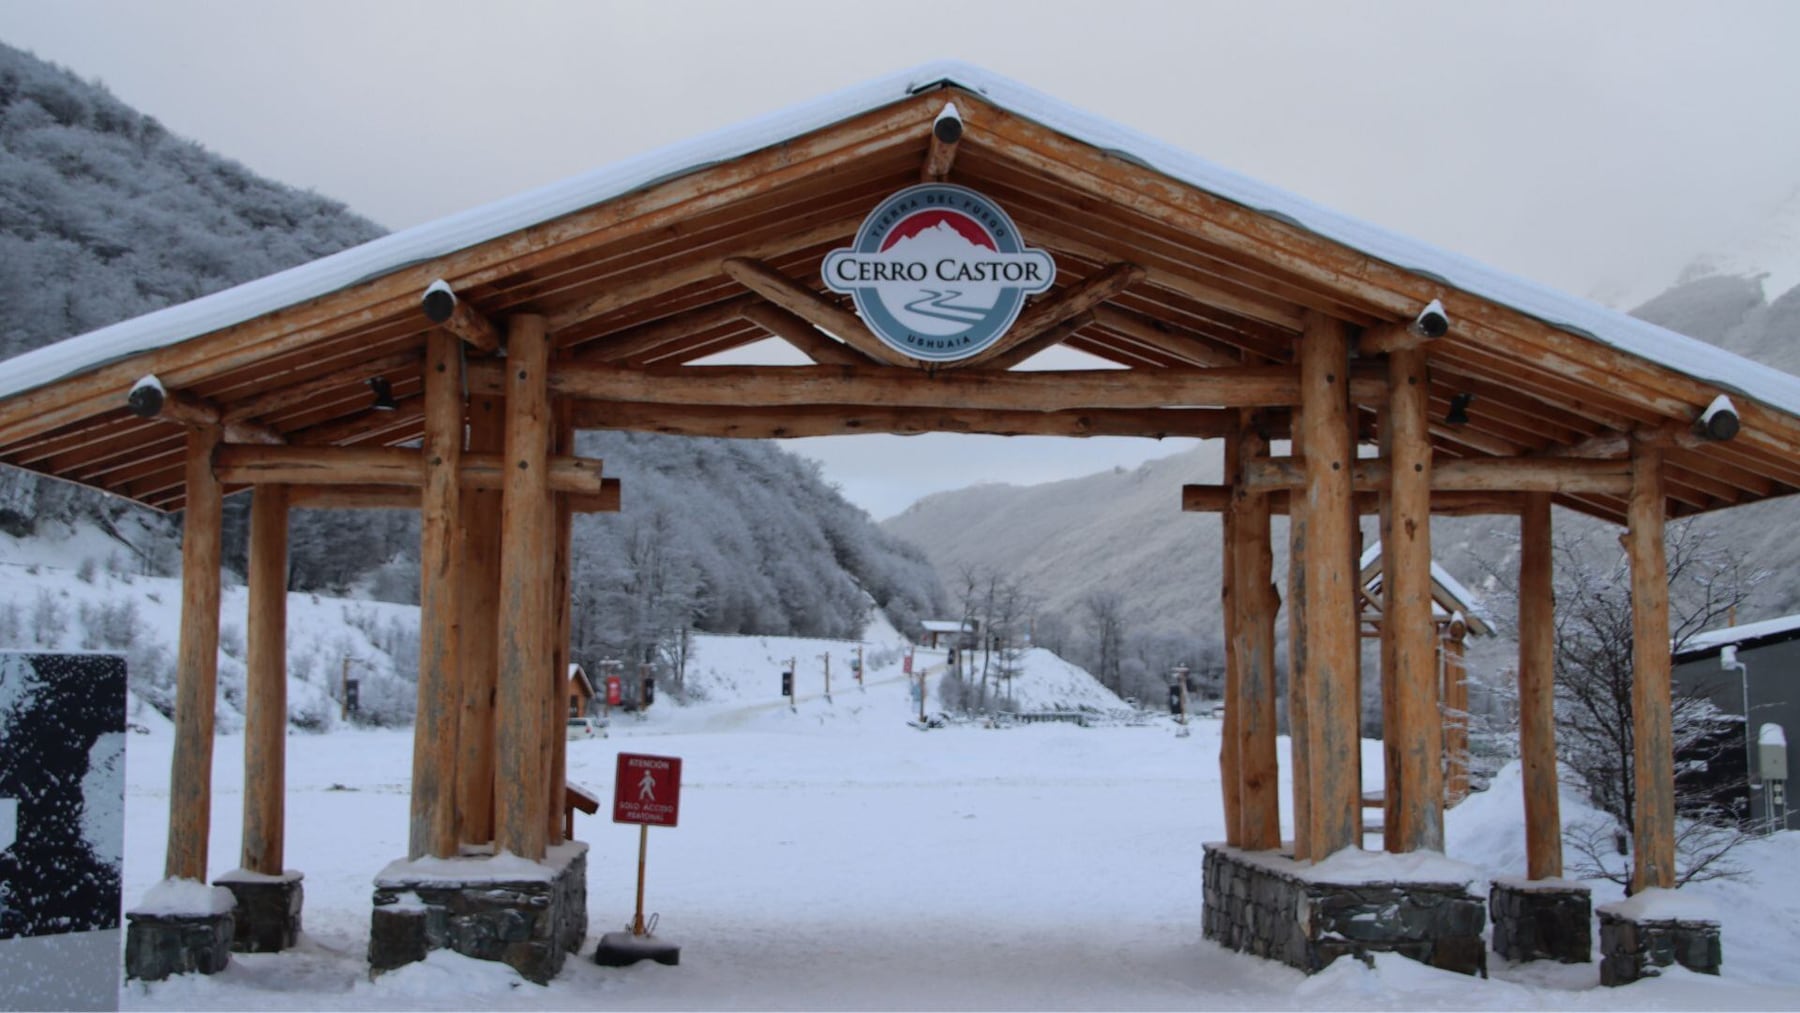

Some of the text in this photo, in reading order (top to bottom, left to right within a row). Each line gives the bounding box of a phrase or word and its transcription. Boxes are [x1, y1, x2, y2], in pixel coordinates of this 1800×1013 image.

[871, 194, 1005, 238] TIERRA DEL FUEGO
[836, 258, 1042, 282] CERRO CASTOR
[907, 333, 971, 349] USHUAIA
